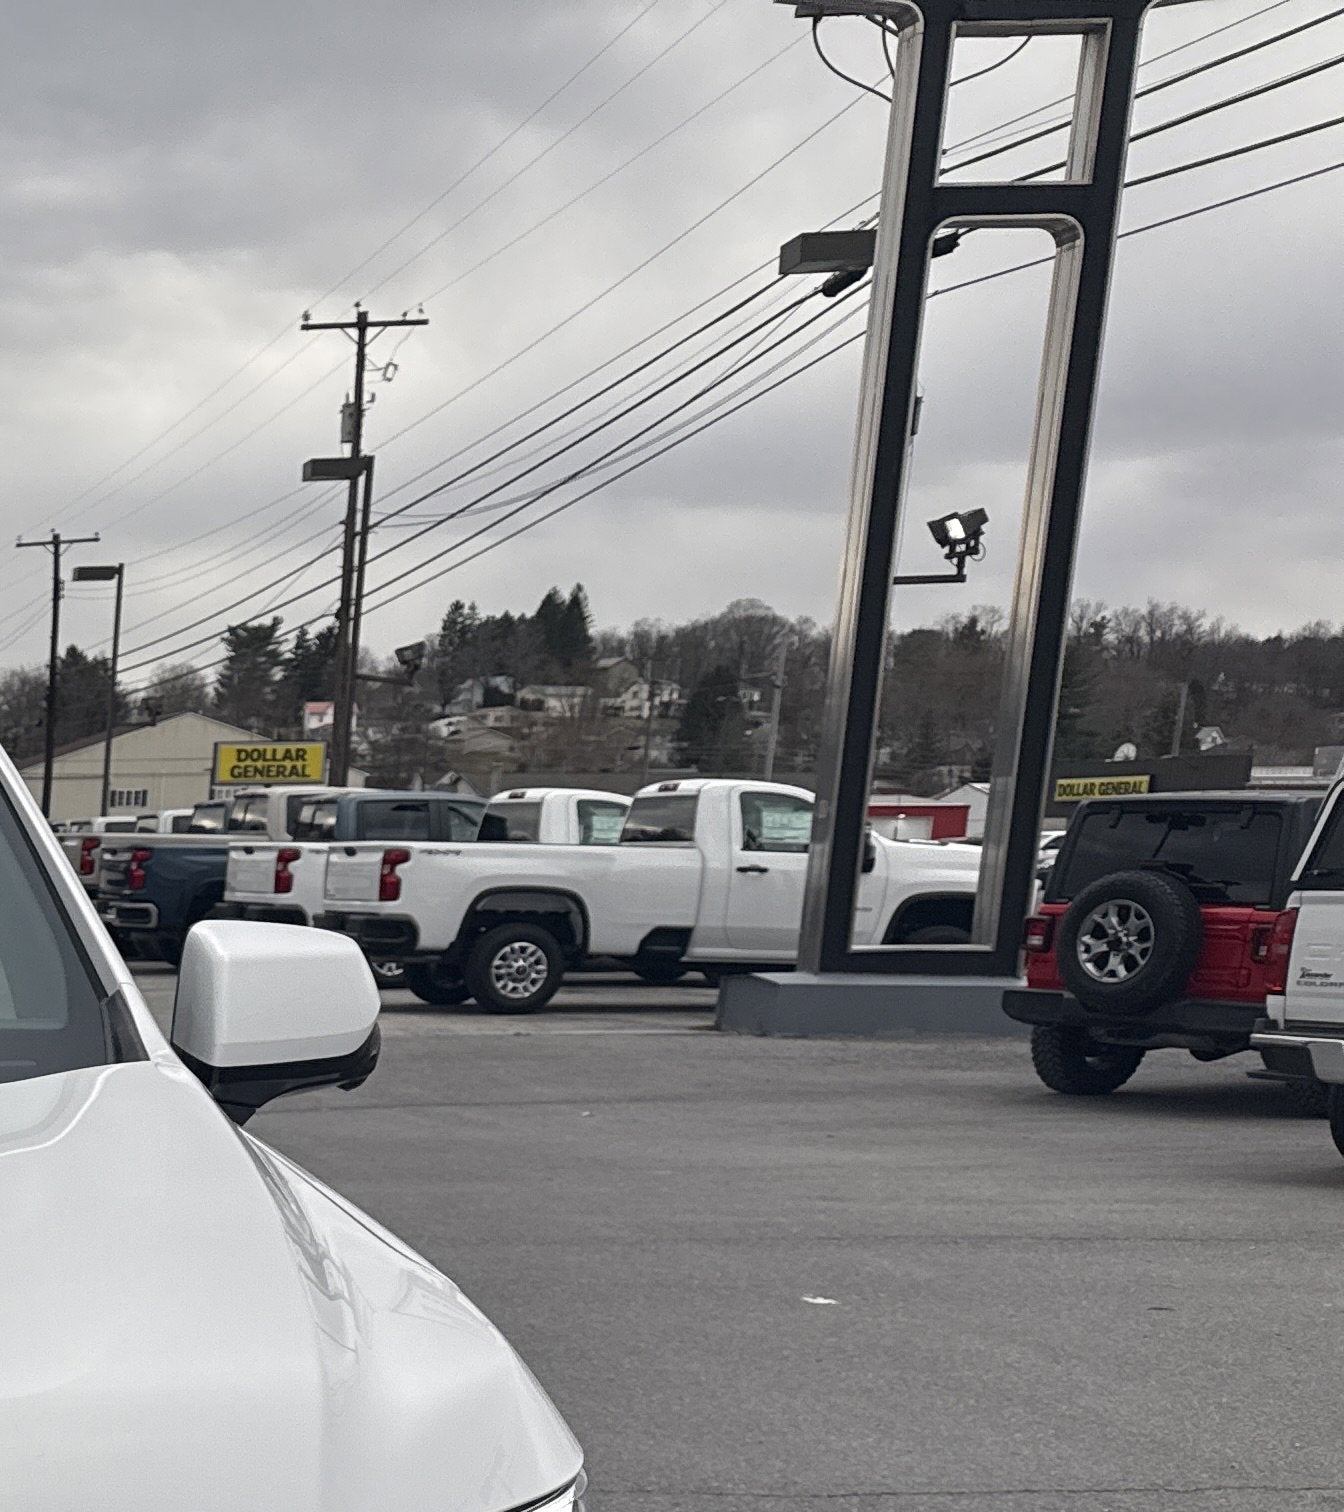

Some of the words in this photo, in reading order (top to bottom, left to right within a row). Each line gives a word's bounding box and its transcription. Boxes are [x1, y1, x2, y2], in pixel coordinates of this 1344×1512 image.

[236, 748, 307, 762] DOLLAR
[230, 764, 311, 778] GENERAL
[1057, 782, 1096, 797] DOLLAR
[1098, 780, 1145, 795] GENERAL
